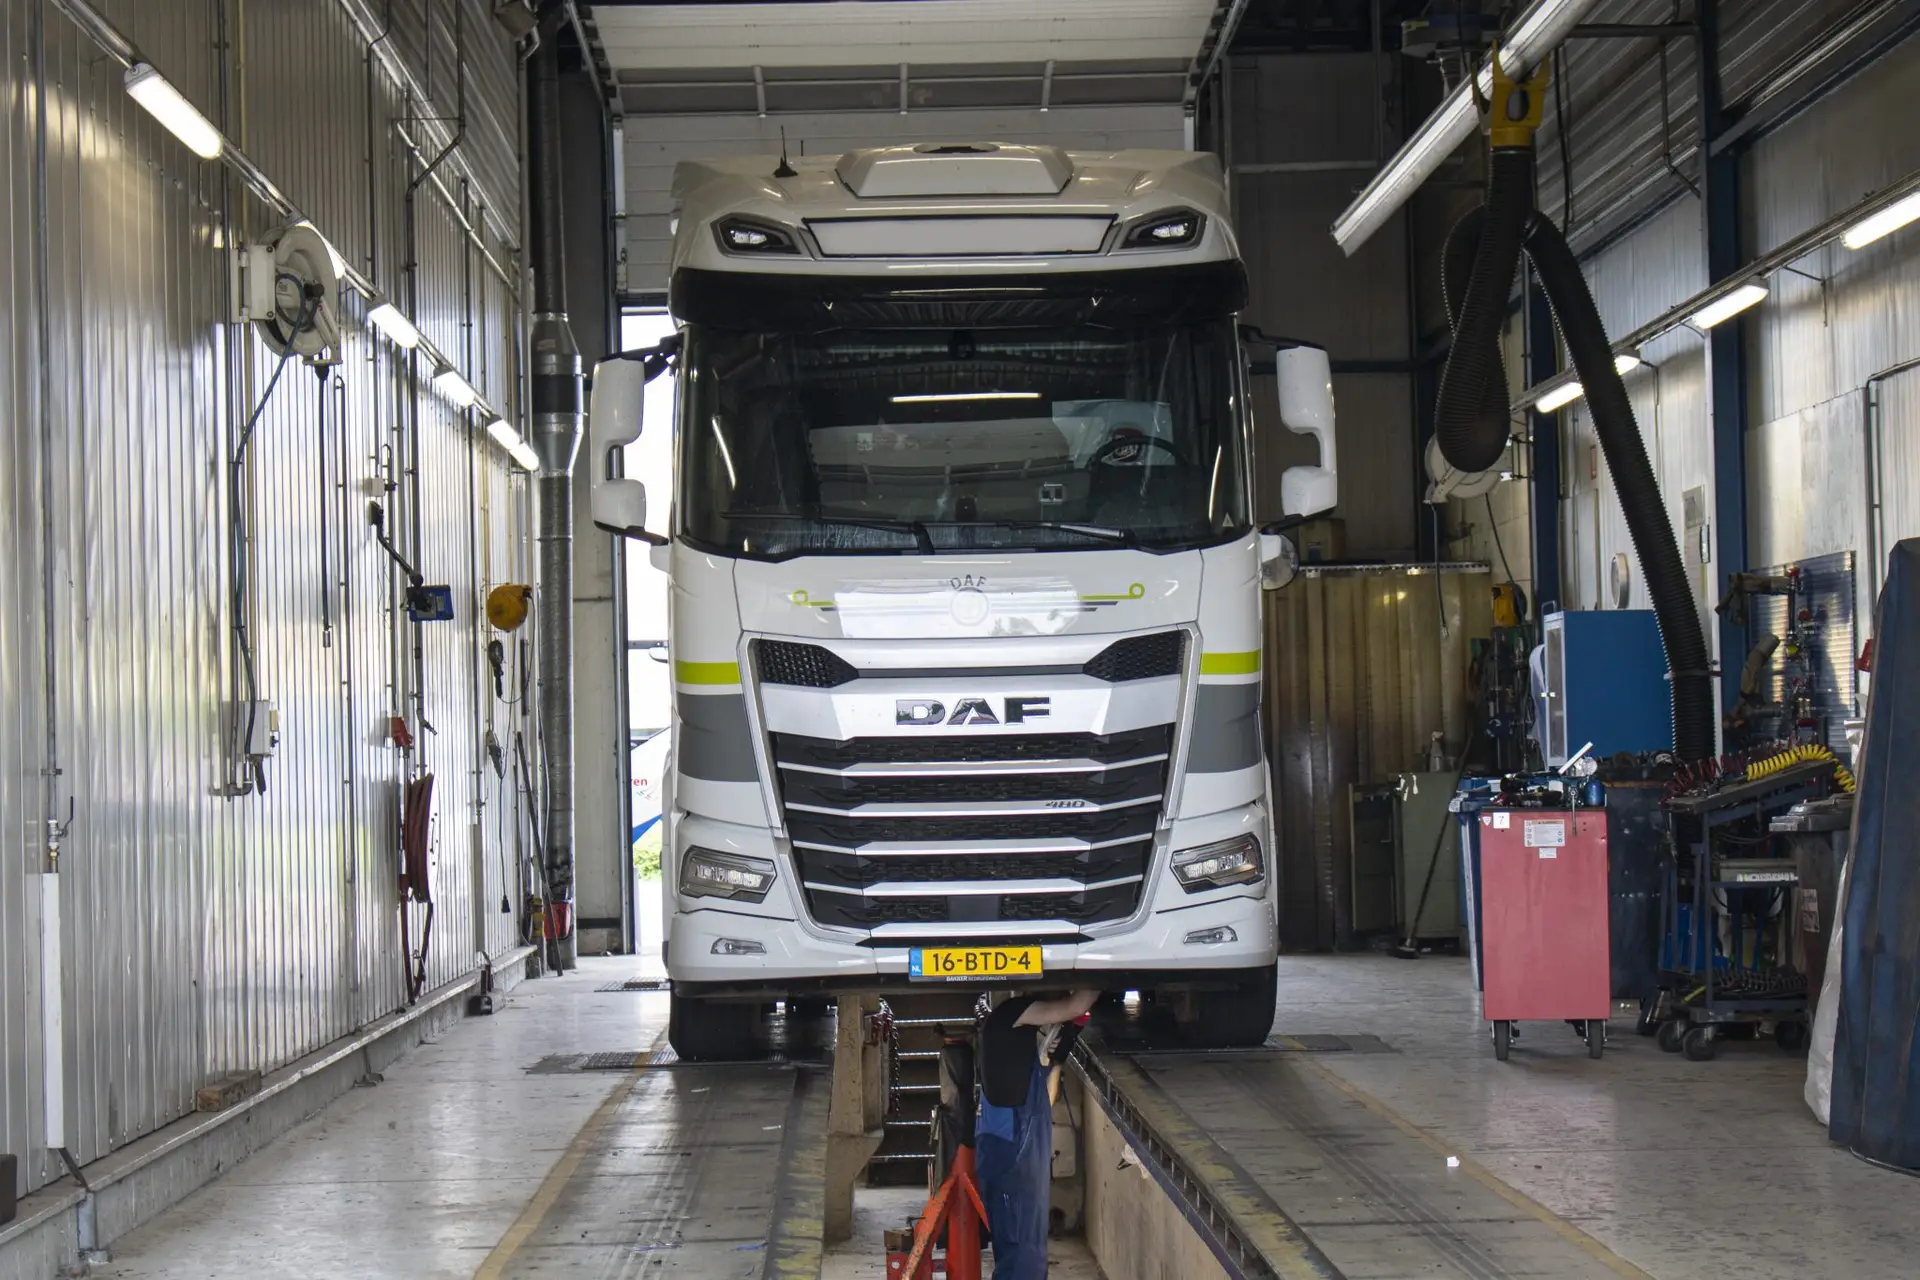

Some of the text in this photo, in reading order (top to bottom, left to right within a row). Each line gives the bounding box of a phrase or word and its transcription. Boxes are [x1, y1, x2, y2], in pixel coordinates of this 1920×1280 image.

[950, 574, 987, 589] DAF
[896, 696, 1050, 725] DAF
[1045, 800, 1085, 808] 480
[933, 951, 1031, 971] 16-BTD-4
